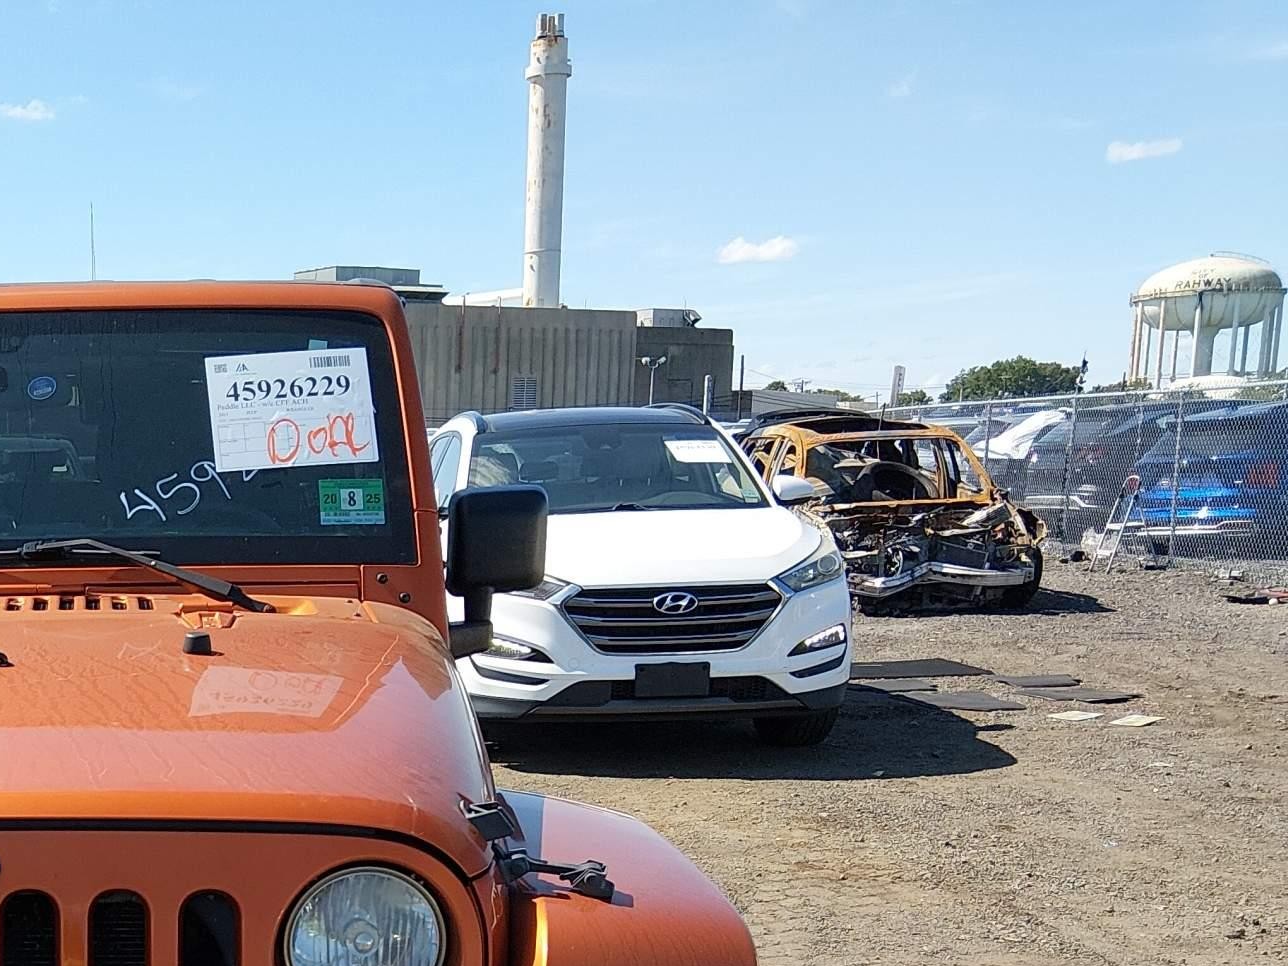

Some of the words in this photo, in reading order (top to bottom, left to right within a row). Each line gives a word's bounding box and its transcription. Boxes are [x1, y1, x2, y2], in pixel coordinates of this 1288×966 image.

[1175, 277, 1232, 290] RAHWAY
[225, 374, 351, 402] 45926229
[119, 460, 258, 522] 459
[323, 493, 337, 505] 20
[347, 490, 357, 507] 8
[365, 493, 381, 504] 25
